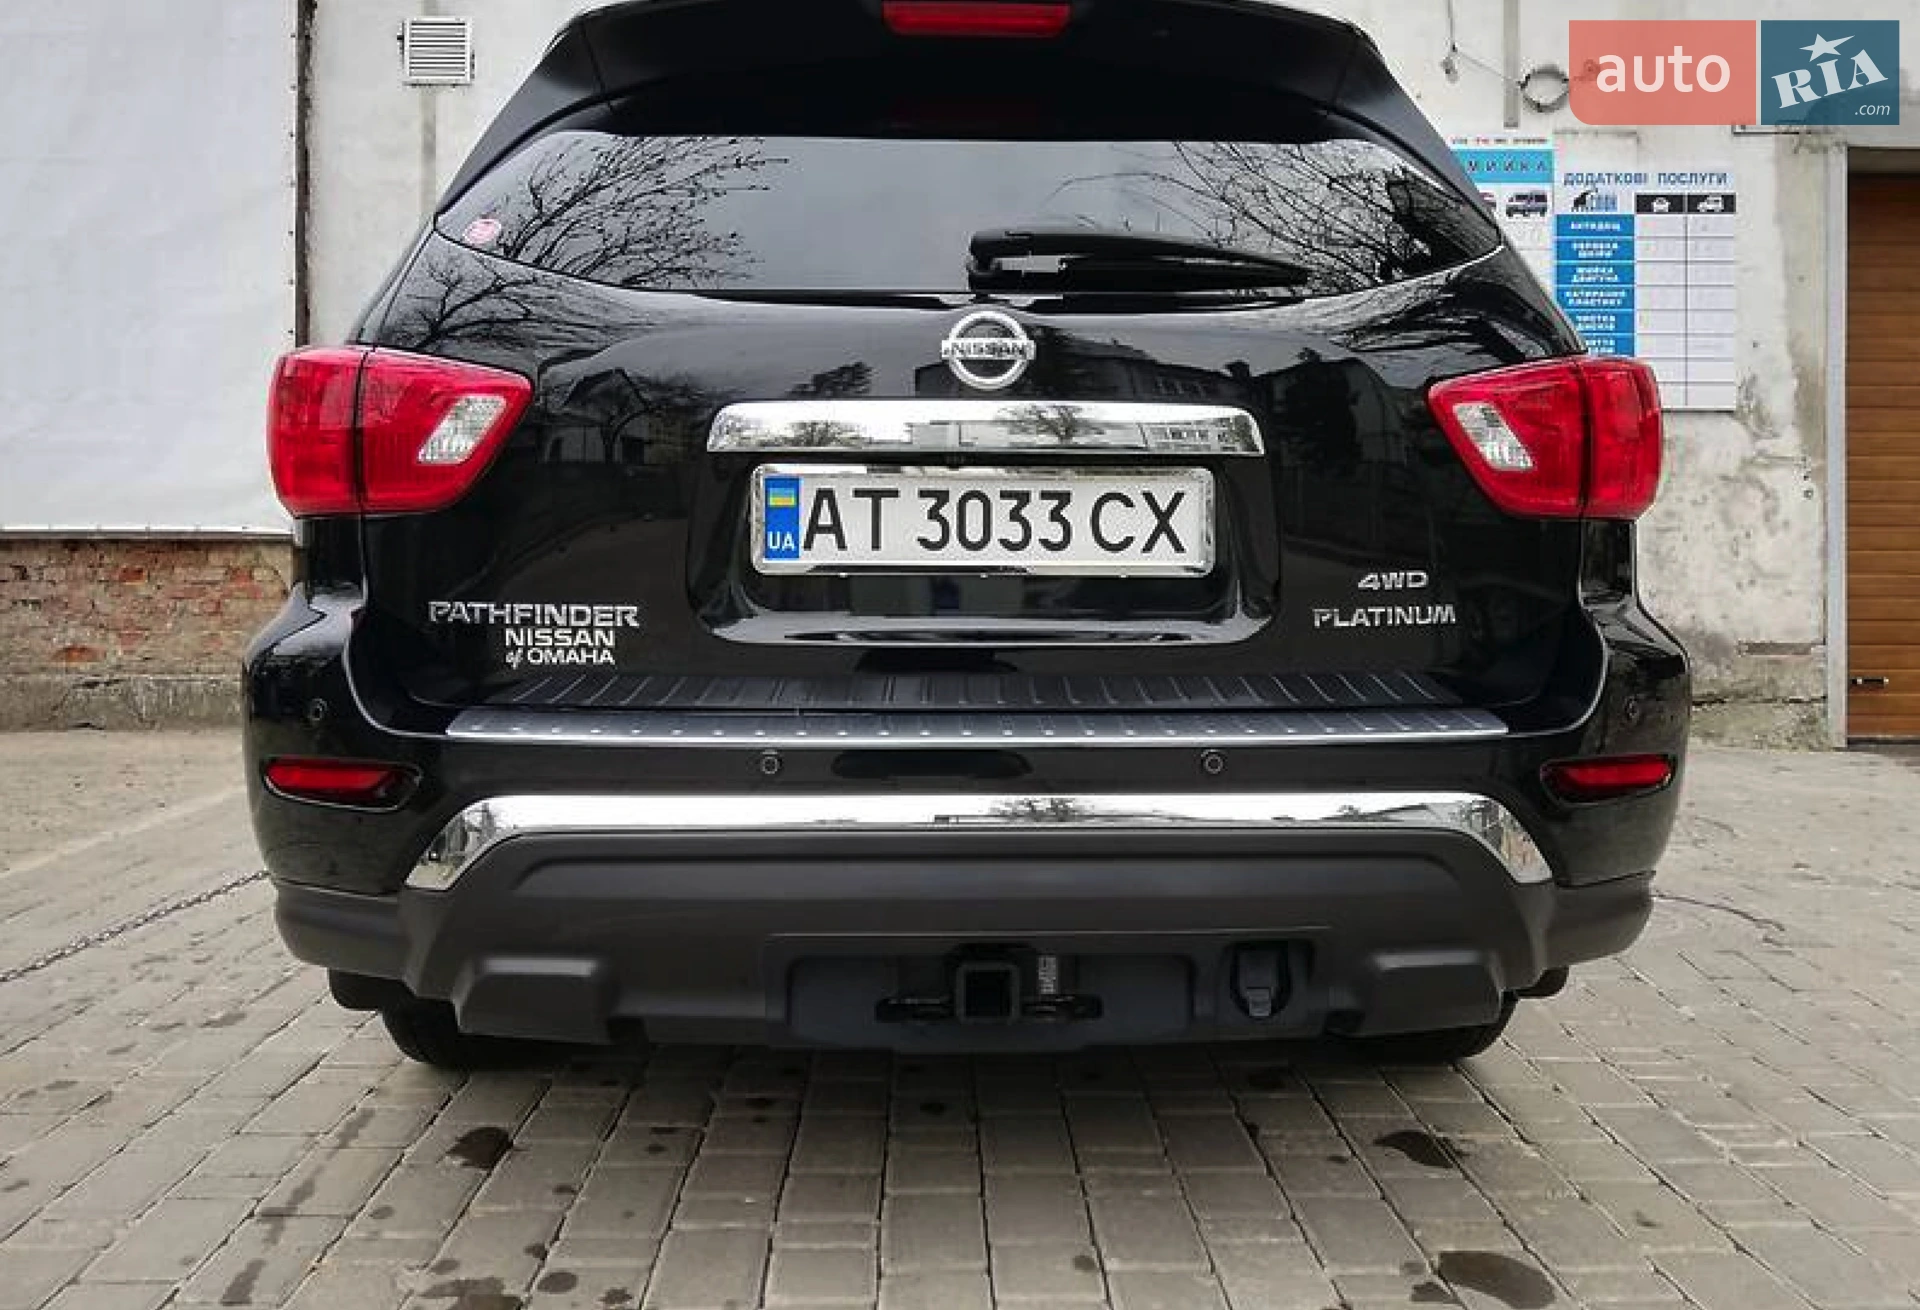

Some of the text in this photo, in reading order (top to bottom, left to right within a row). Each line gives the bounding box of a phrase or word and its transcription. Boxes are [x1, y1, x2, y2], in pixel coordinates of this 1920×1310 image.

[1564, 172, 1728, 186] ДОДАТКОВІ ПОСЛУГИ
[950, 341, 1023, 357] NISSAN
[803, 488, 1187, 554] AT 3033 CX
[768, 531, 795, 551] UA
[1357, 571, 1429, 590] 4WD
[428, 601, 640, 628] PATHFINDER
[1312, 604, 1456, 627] PLATINUM
[505, 627, 615, 647] NISSAN
[505, 648, 616, 669] of OMAHA
